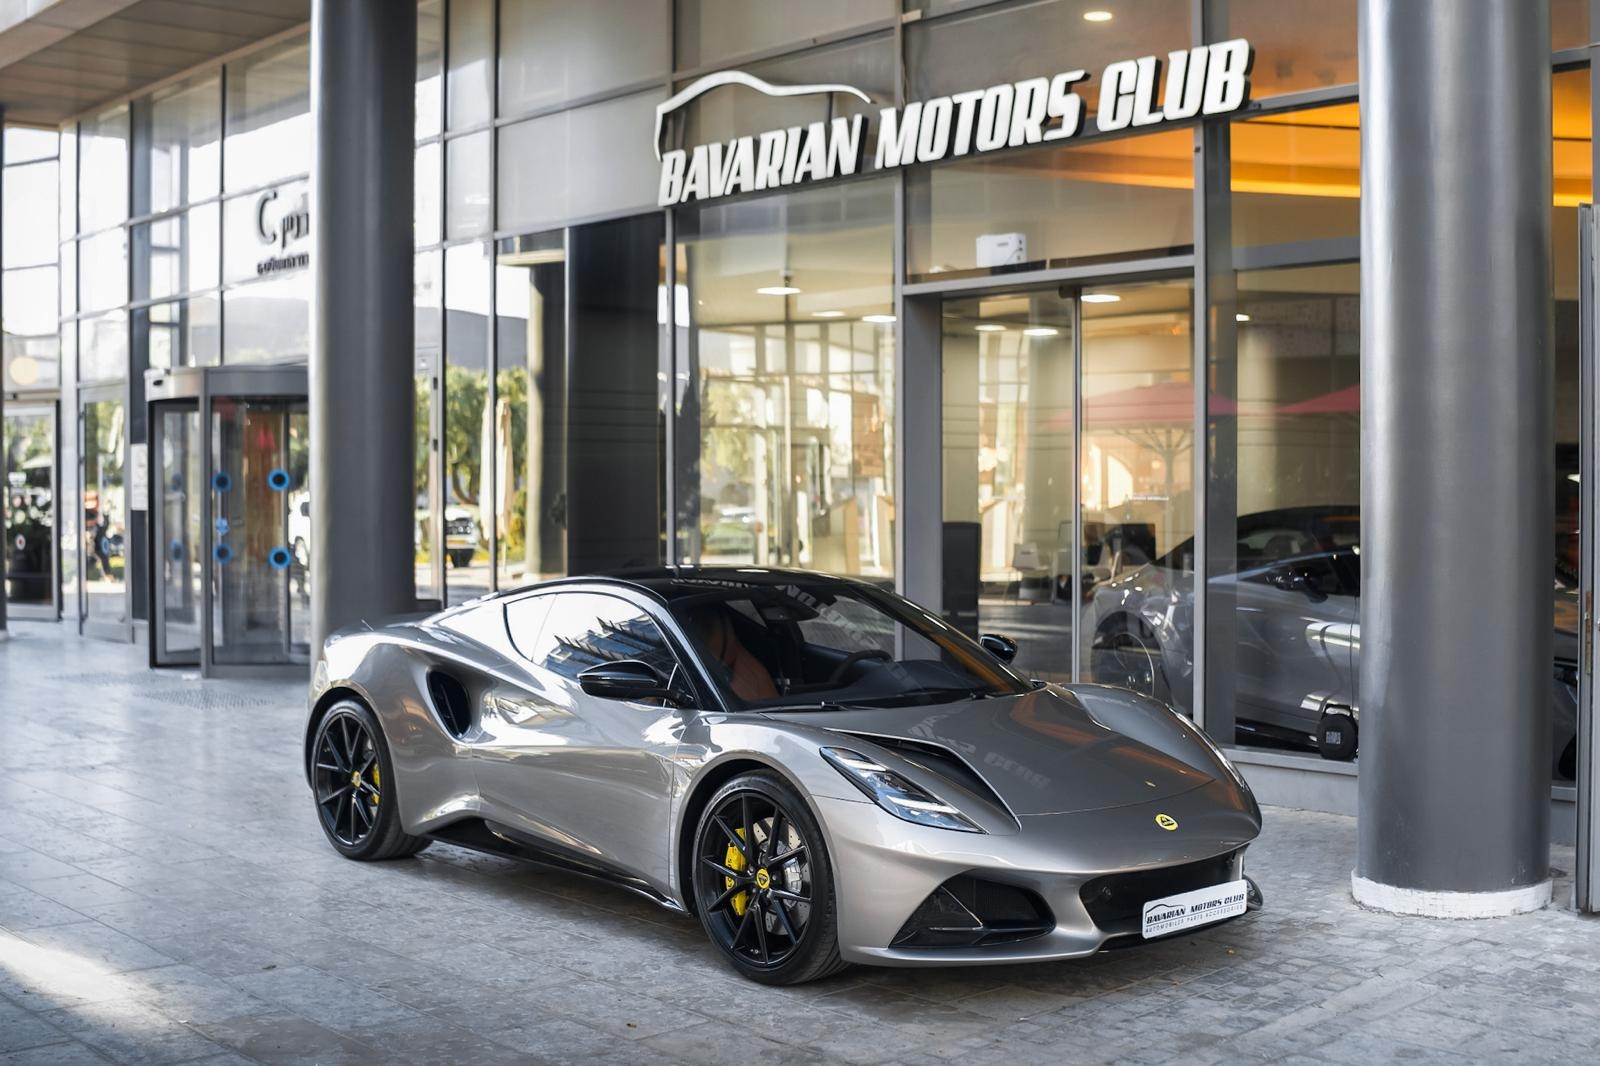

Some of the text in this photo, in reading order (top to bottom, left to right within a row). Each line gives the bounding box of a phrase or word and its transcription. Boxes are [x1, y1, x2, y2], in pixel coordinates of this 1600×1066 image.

[657, 38, 1251, 207] BAVARIAN MOTORS CLUB
[1146, 893, 1244, 924] BAVARIAN MOTORS CLUB
